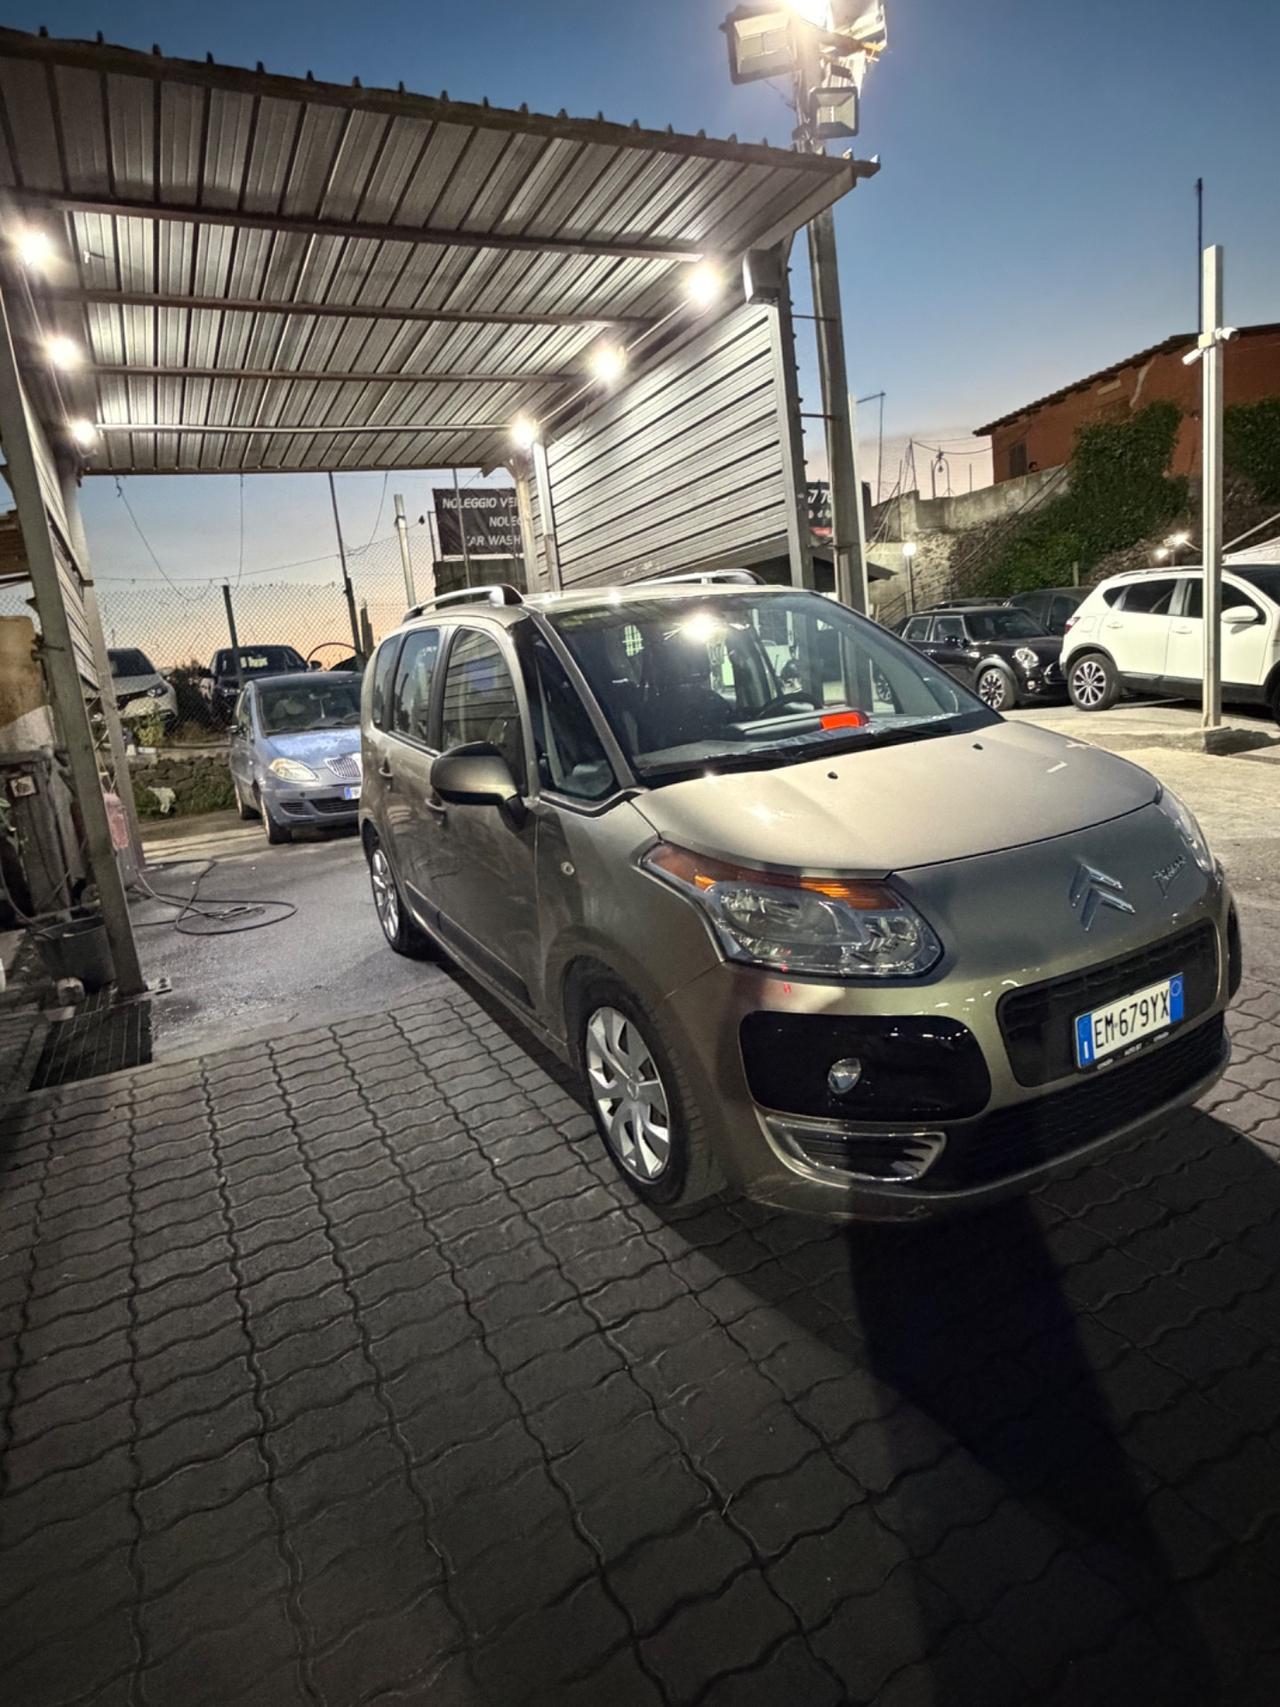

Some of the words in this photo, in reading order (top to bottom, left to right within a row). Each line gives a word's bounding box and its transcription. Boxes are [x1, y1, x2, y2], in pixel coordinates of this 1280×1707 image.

[442, 497, 497, 509] NOLEGGIO
[466, 536, 485, 546] AR
[488, 535, 520, 546] WASH
